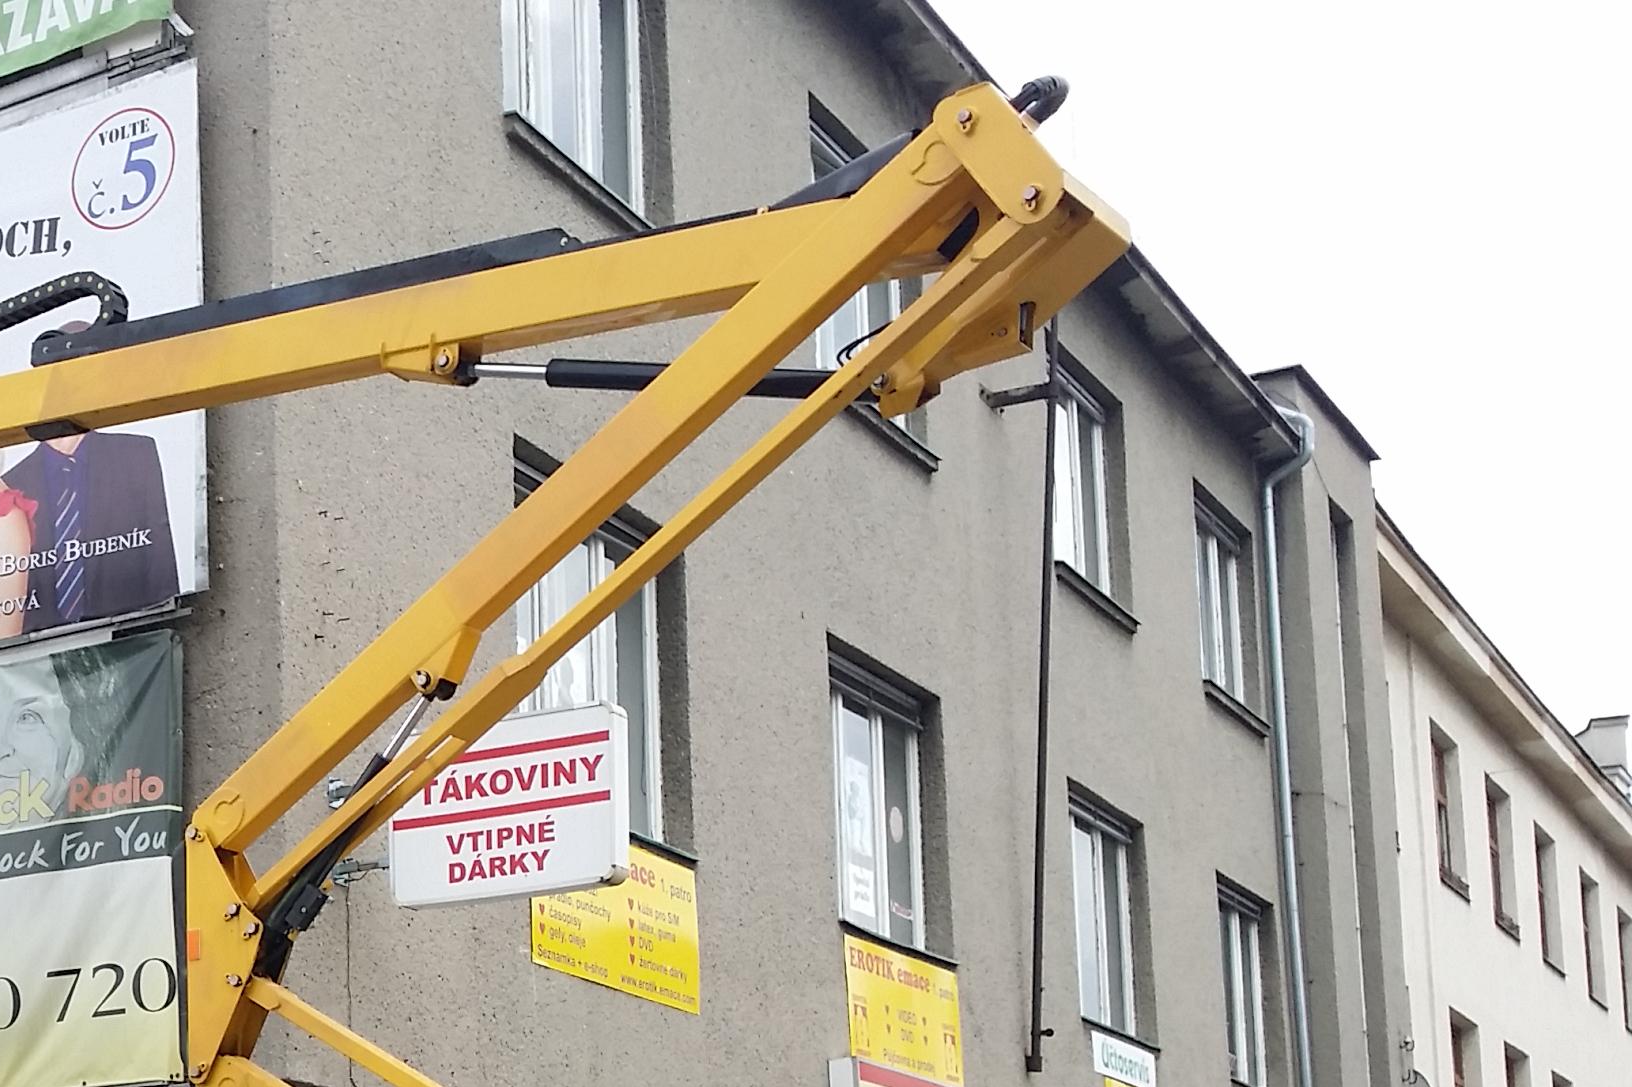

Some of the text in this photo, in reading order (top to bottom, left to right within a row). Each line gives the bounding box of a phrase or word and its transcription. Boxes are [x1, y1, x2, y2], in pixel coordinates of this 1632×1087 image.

[98, 118, 150, 147] VOLTE
[120, 133, 158, 211] 5
[68, 766, 165, 813] Radio
[419, 751, 605, 808] TÁKOVINY
[61, 830, 105, 867] For
[115, 816, 167, 858] You
[445, 814, 557, 856] VTIPNÉ
[448, 848, 551, 885] DÁRKY
[537, 943, 576, 968] Seznamka
[638, 936, 654, 953] DVD
[46, 957, 177, 1024] 720
[849, 946, 930, 993] EROTIK emace
[1101, 1038, 1151, 1084] Účtoservis
